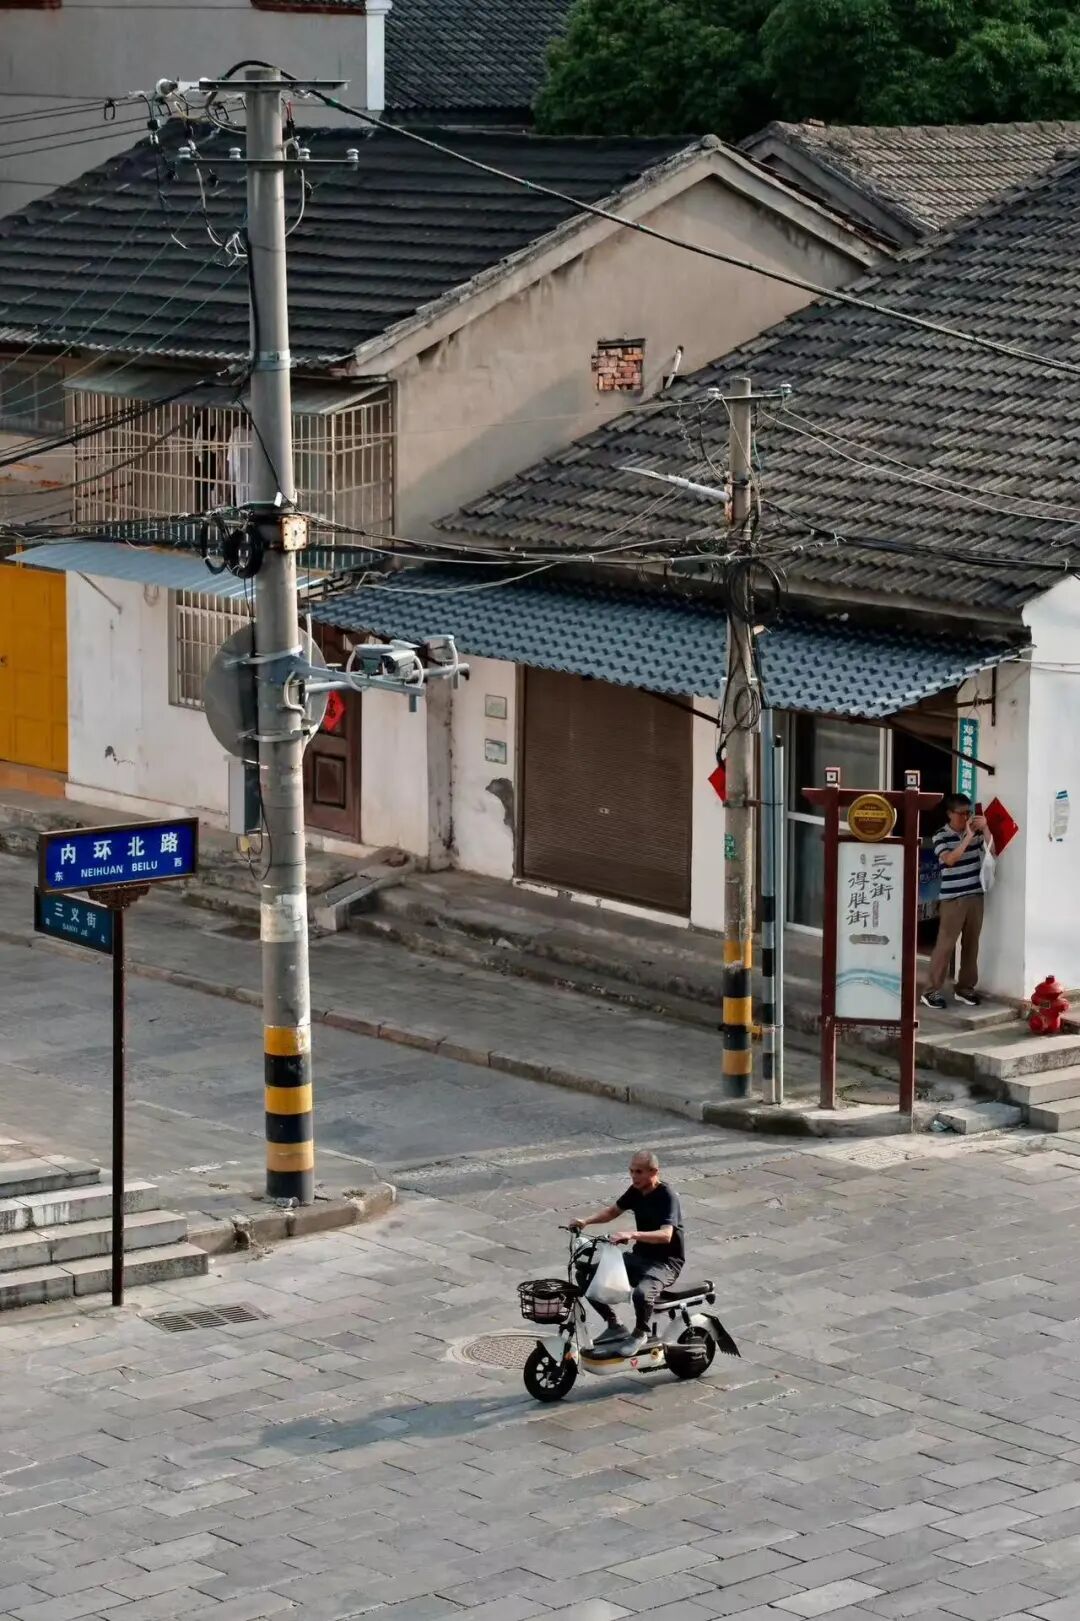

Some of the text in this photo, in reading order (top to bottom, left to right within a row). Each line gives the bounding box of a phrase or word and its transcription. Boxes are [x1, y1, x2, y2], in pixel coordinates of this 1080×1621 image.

[60, 832, 179, 865] 内环北路
[80, 860, 158, 878] NEIHUAN BEILU
[173, 857, 183, 868] 西
[54, 871, 64, 882] 东
[870, 855, 894, 901] 三义街
[846, 871, 870, 928] 得胜街
[54, 902, 97, 928] 三义街
